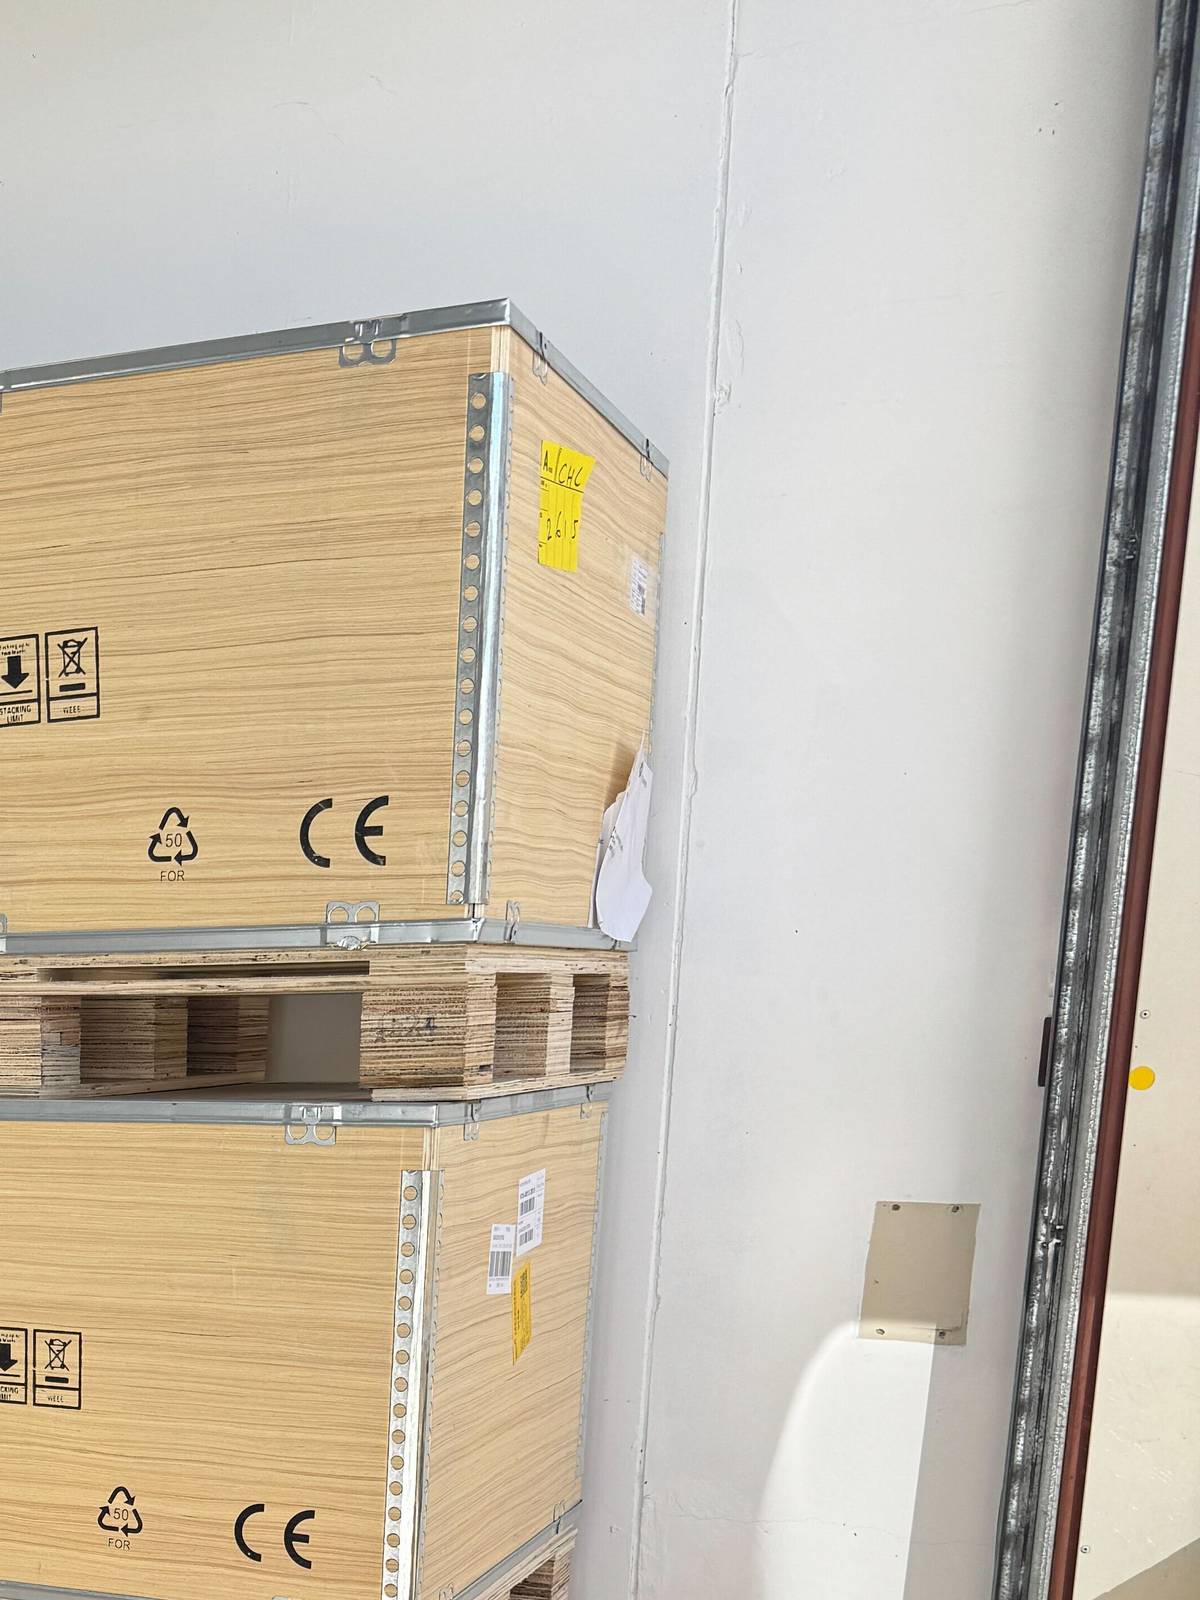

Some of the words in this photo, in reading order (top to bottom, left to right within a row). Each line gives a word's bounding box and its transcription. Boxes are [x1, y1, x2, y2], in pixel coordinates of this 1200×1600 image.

[0, 705, 32, 715] STACKING
[7, 714, 23, 724] LIMIT
[300, 795, 389, 868] CE
[165, 833, 183, 848] 50
[160, 870, 185, 882] FOR
[113, 1507, 130, 1522] 50
[234, 1503, 315, 1569] CE
[108, 1537, 131, 1550] FOR
